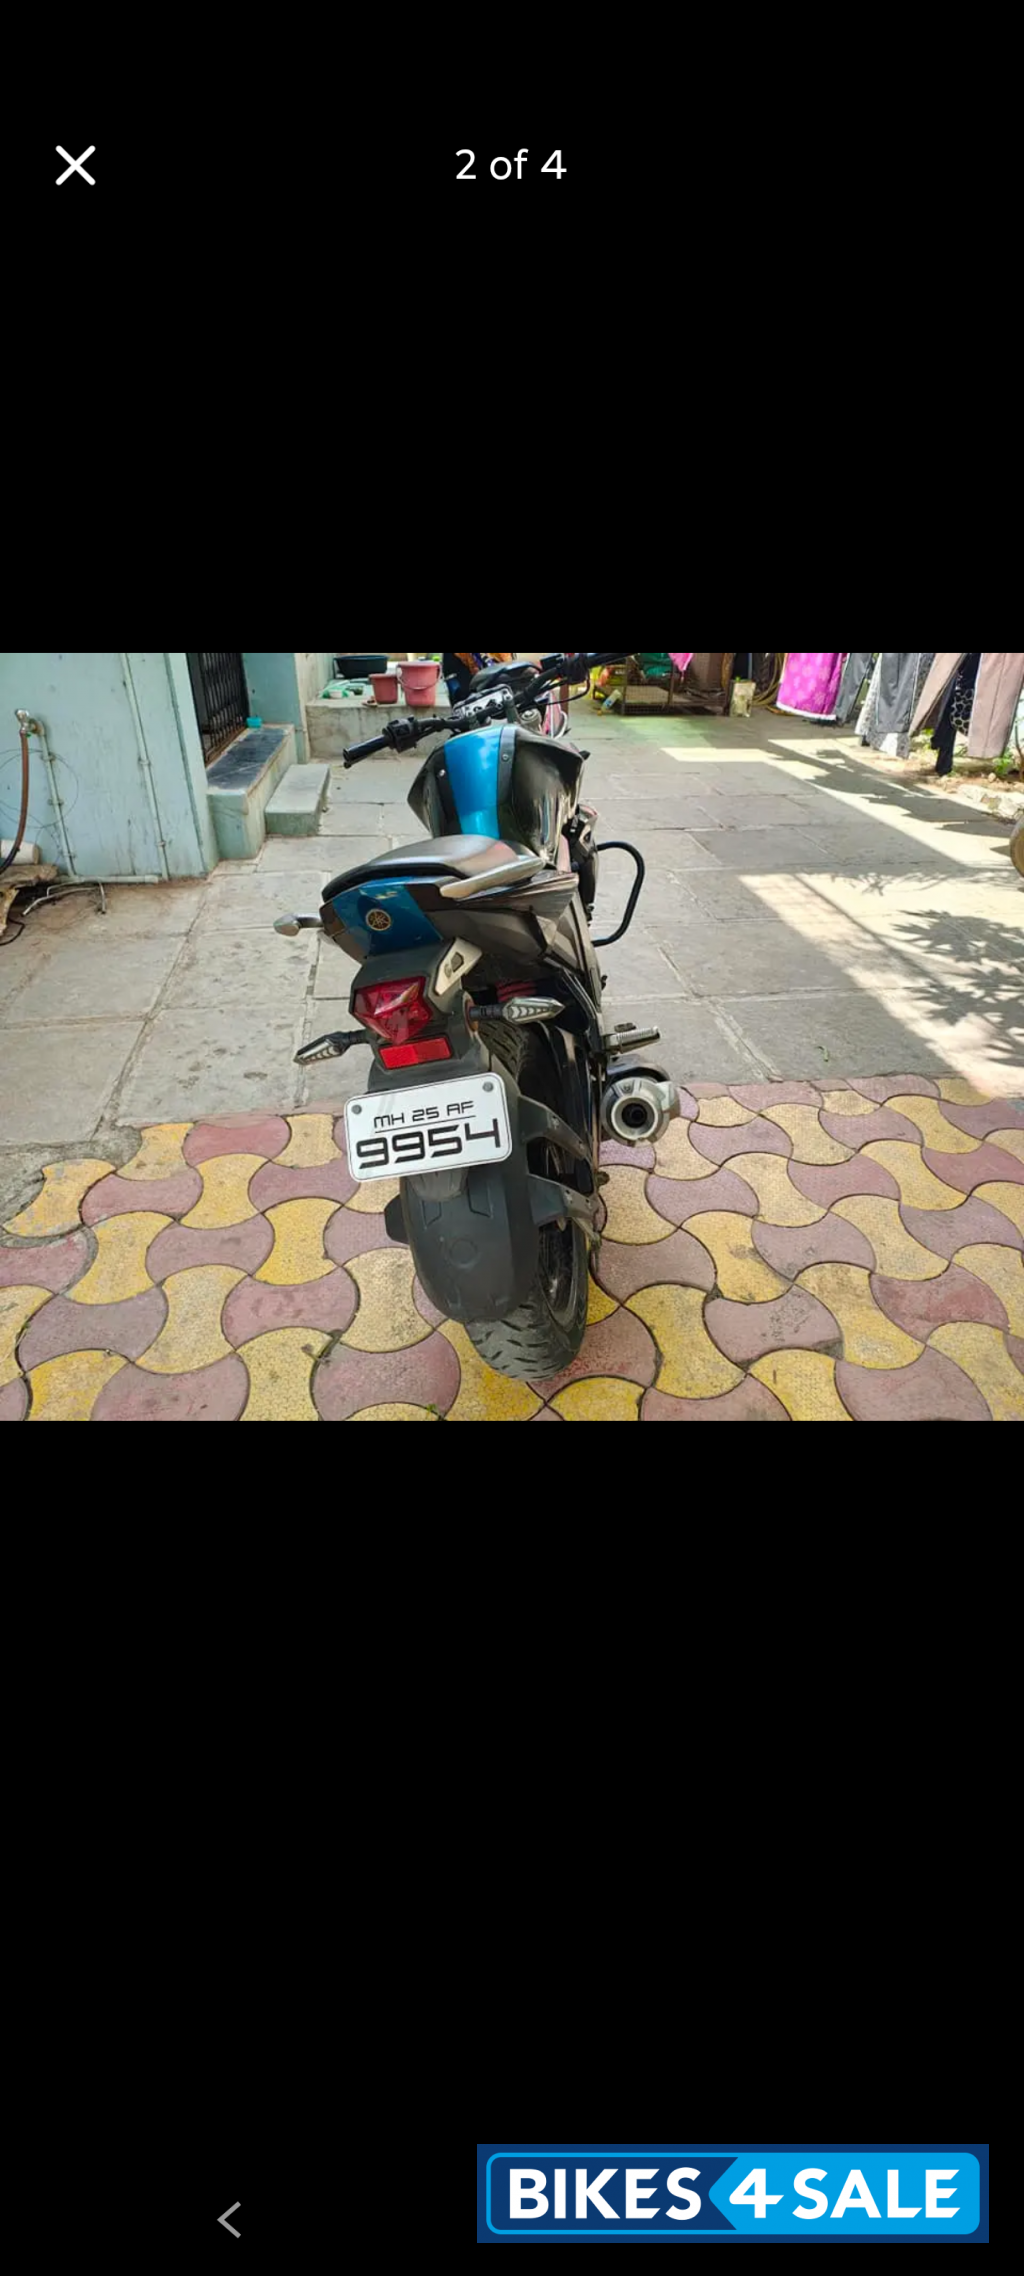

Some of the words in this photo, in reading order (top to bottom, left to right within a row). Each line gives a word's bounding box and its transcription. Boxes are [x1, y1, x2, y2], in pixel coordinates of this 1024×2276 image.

[373, 1112, 405, 1129] MH
[412, 1106, 440, 1123] 25
[446, 1100, 475, 1117] AF
[355, 1117, 501, 1170] 9954
